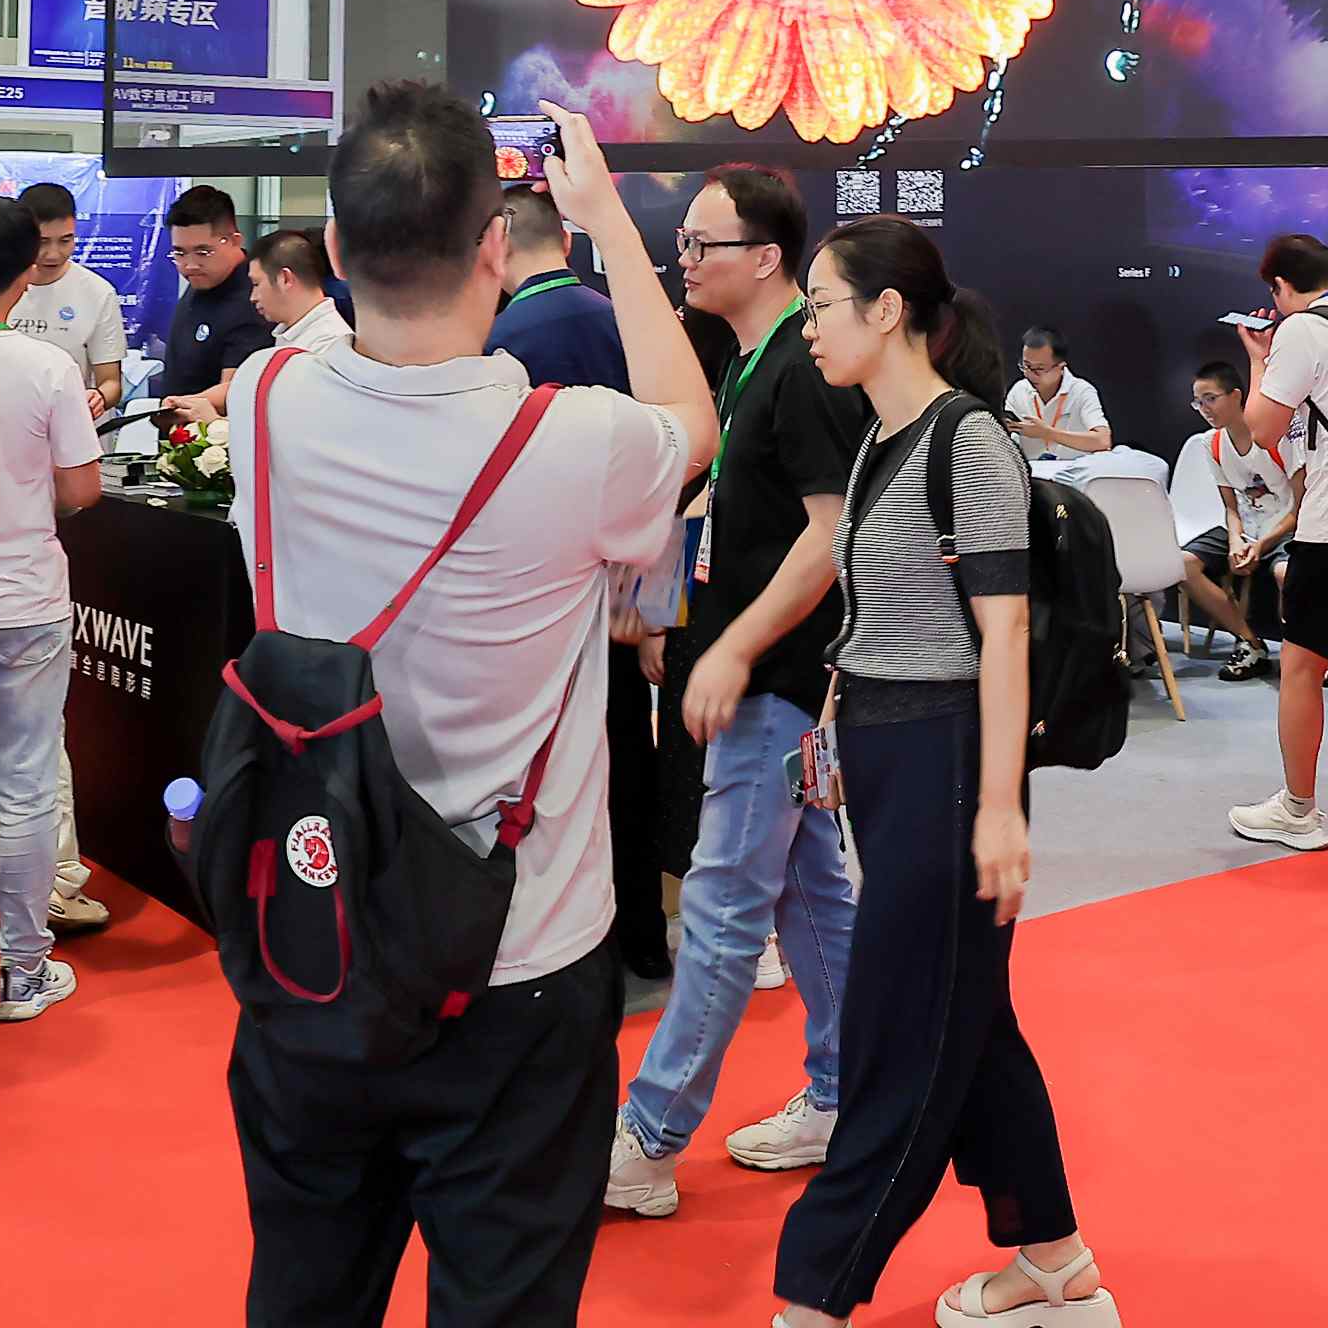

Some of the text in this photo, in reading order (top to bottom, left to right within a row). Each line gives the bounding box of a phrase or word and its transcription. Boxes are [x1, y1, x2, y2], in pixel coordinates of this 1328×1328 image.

[113, 88, 215, 104] AV数字音视工程网
[71, 601, 154, 668] XWAVE
